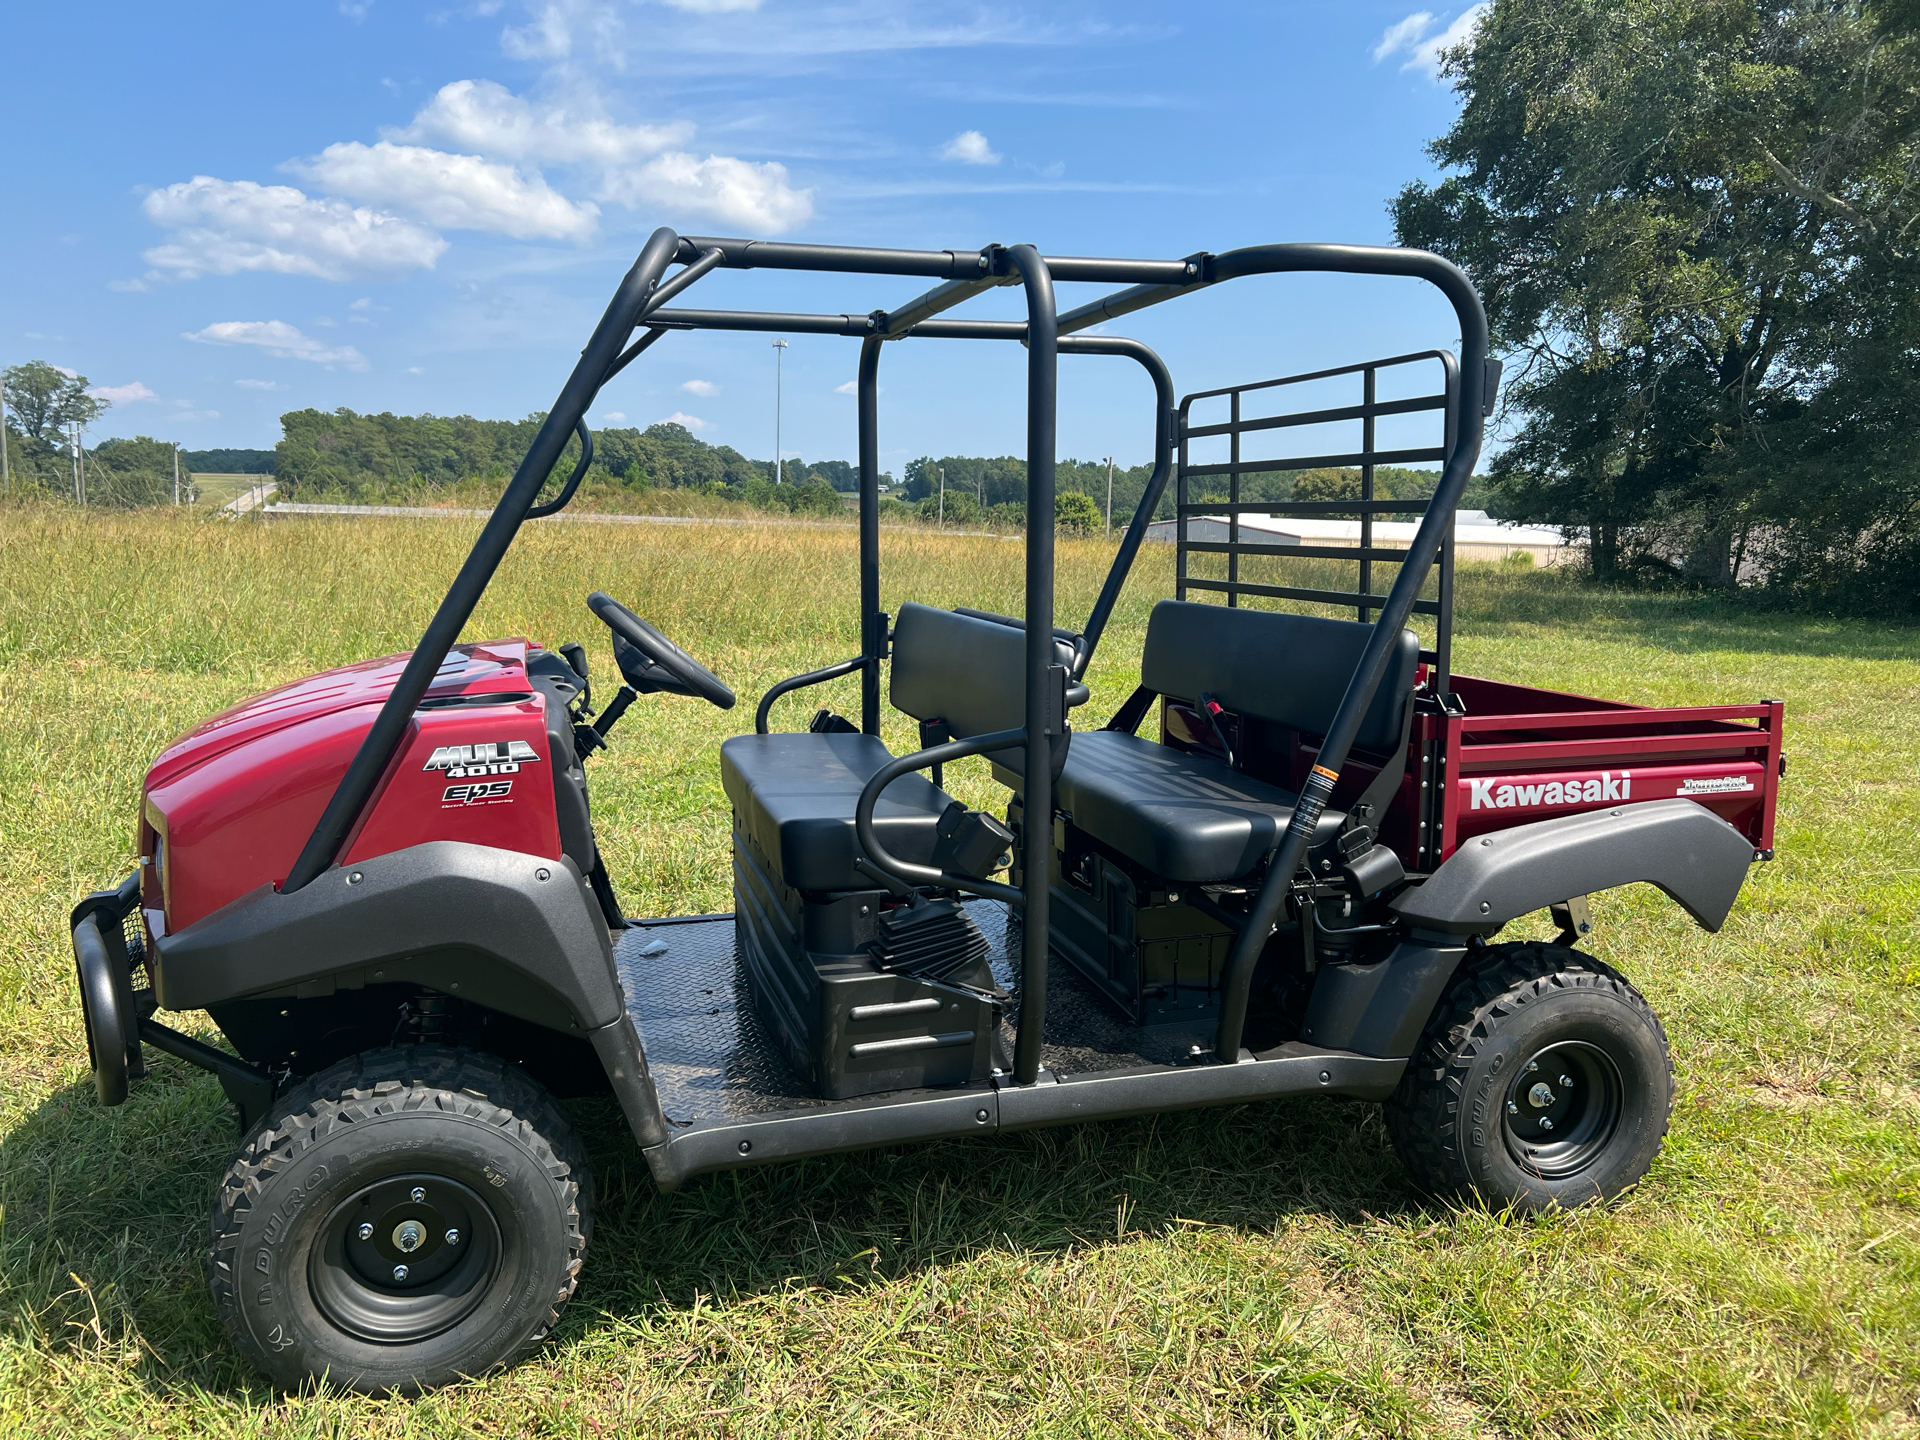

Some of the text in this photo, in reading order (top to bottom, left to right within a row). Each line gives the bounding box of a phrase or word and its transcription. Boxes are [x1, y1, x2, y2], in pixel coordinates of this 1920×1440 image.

[422, 740, 541, 771] MULE
[447, 763, 519, 778] 4010
[442, 780, 513, 803] EPS
[1469, 771, 1631, 810] Kawasaki
[1472, 1053, 1504, 1147] DURO
[255, 1165, 329, 1276] DURO
